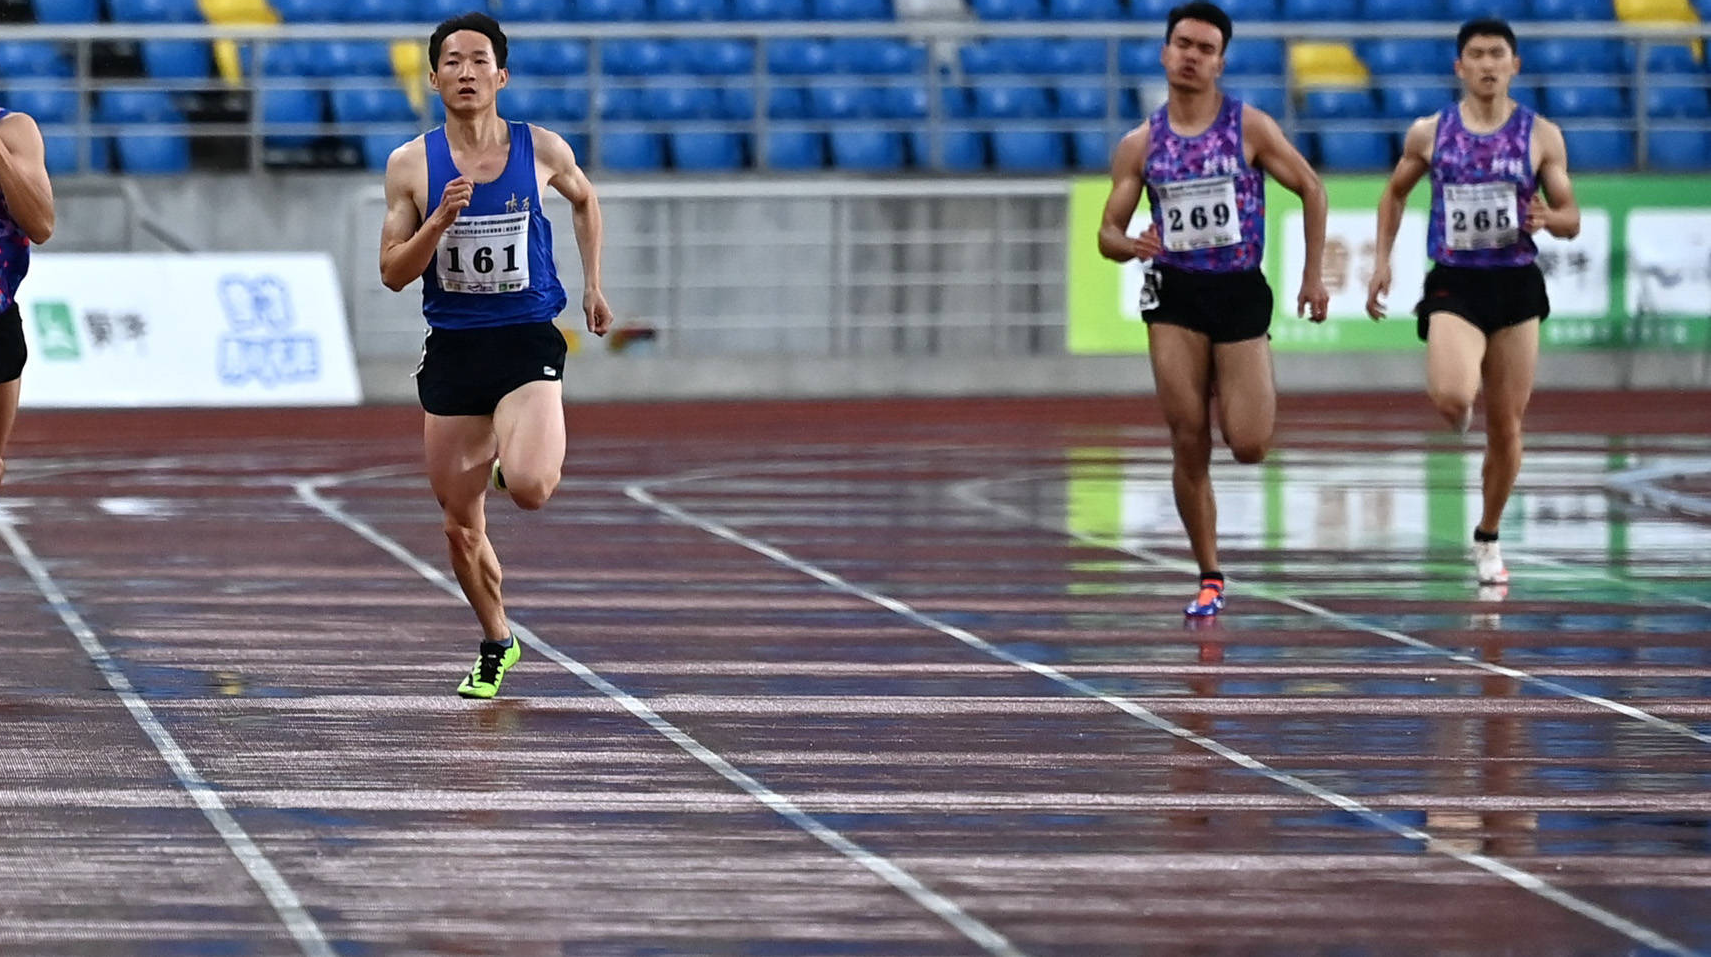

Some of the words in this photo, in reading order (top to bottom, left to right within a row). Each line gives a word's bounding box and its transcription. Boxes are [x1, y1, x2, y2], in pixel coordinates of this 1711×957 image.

[1168, 202, 1231, 232] 269
[1451, 208, 1511, 232] 265
[446, 244, 520, 274] 161
